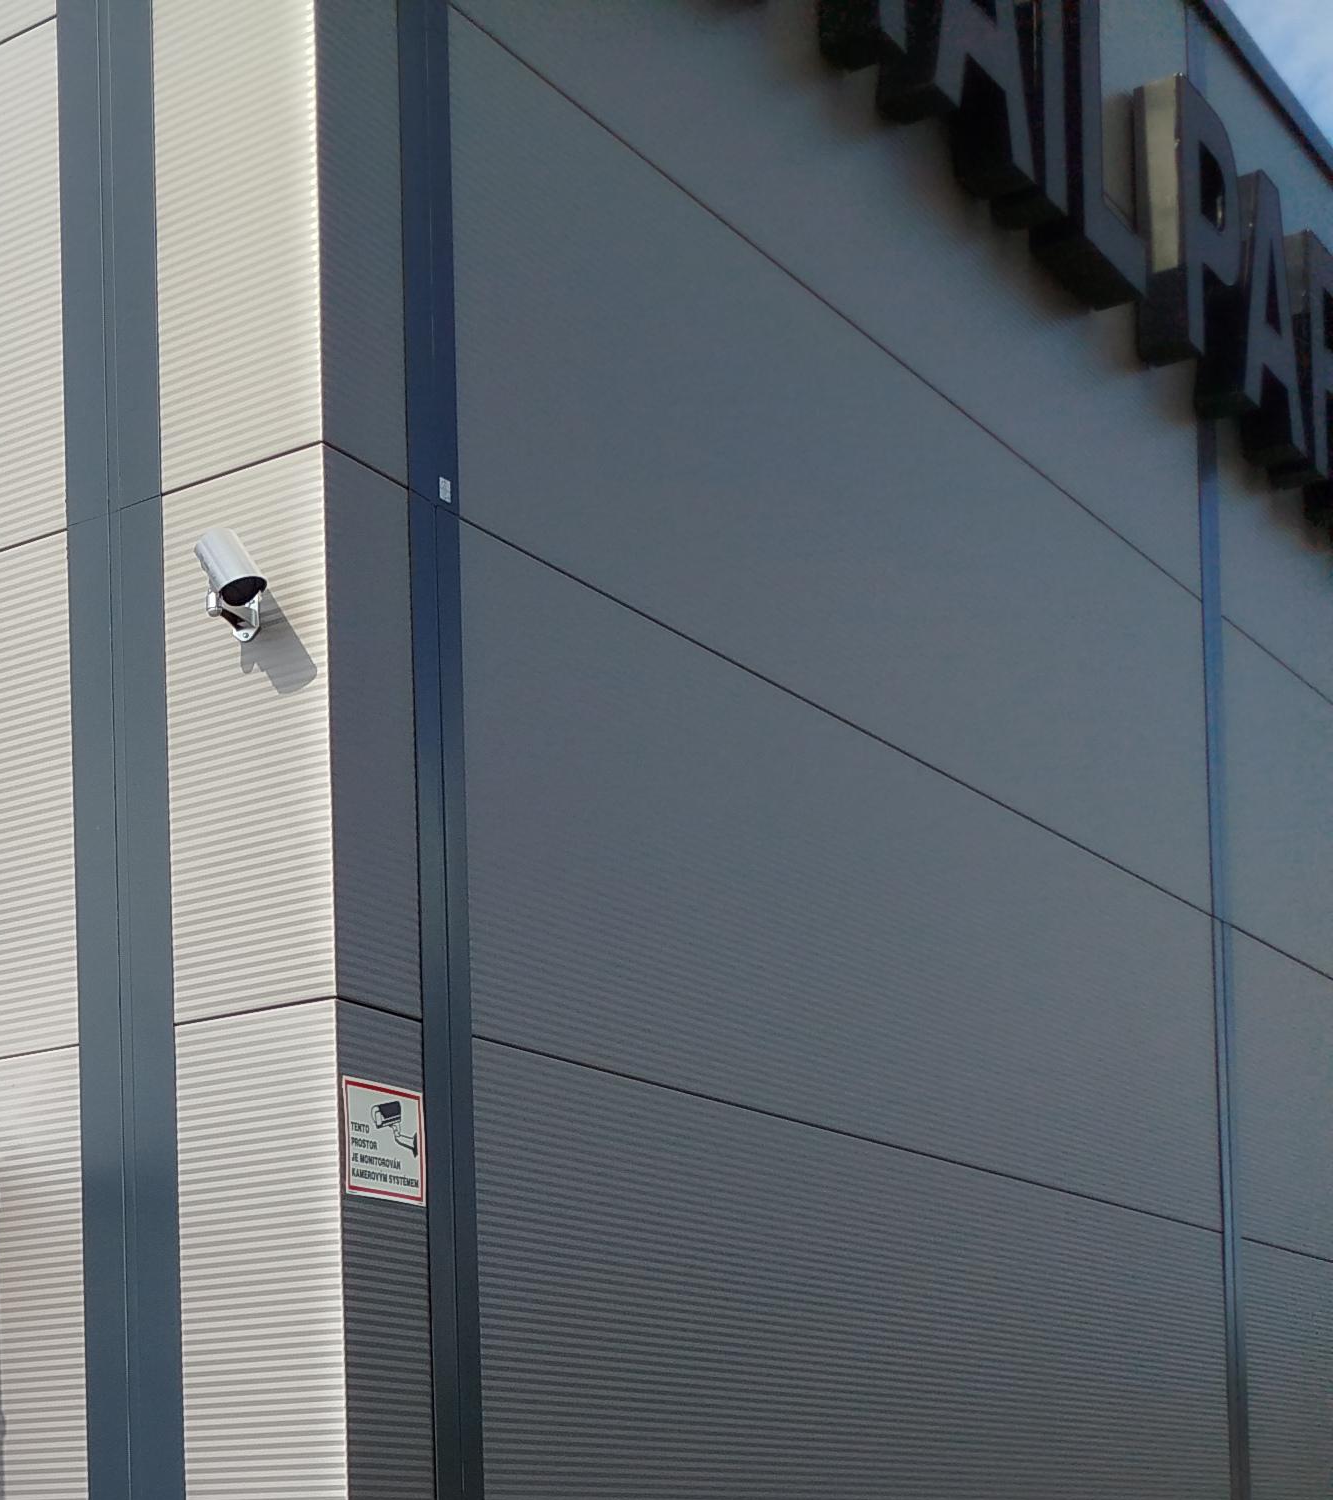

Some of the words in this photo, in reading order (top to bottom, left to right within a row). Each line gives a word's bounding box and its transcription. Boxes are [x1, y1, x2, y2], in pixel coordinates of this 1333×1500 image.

[350, 1121, 370, 1134] TENTO
[351, 1136, 378, 1151] PROSTOR
[351, 1152, 359, 1163] JE
[359, 1153, 401, 1171] MONITOROVÁN
[351, 1167, 388, 1183] KAMEROVÝM
[388, 1172, 419, 1189] SYSTÉMEM
